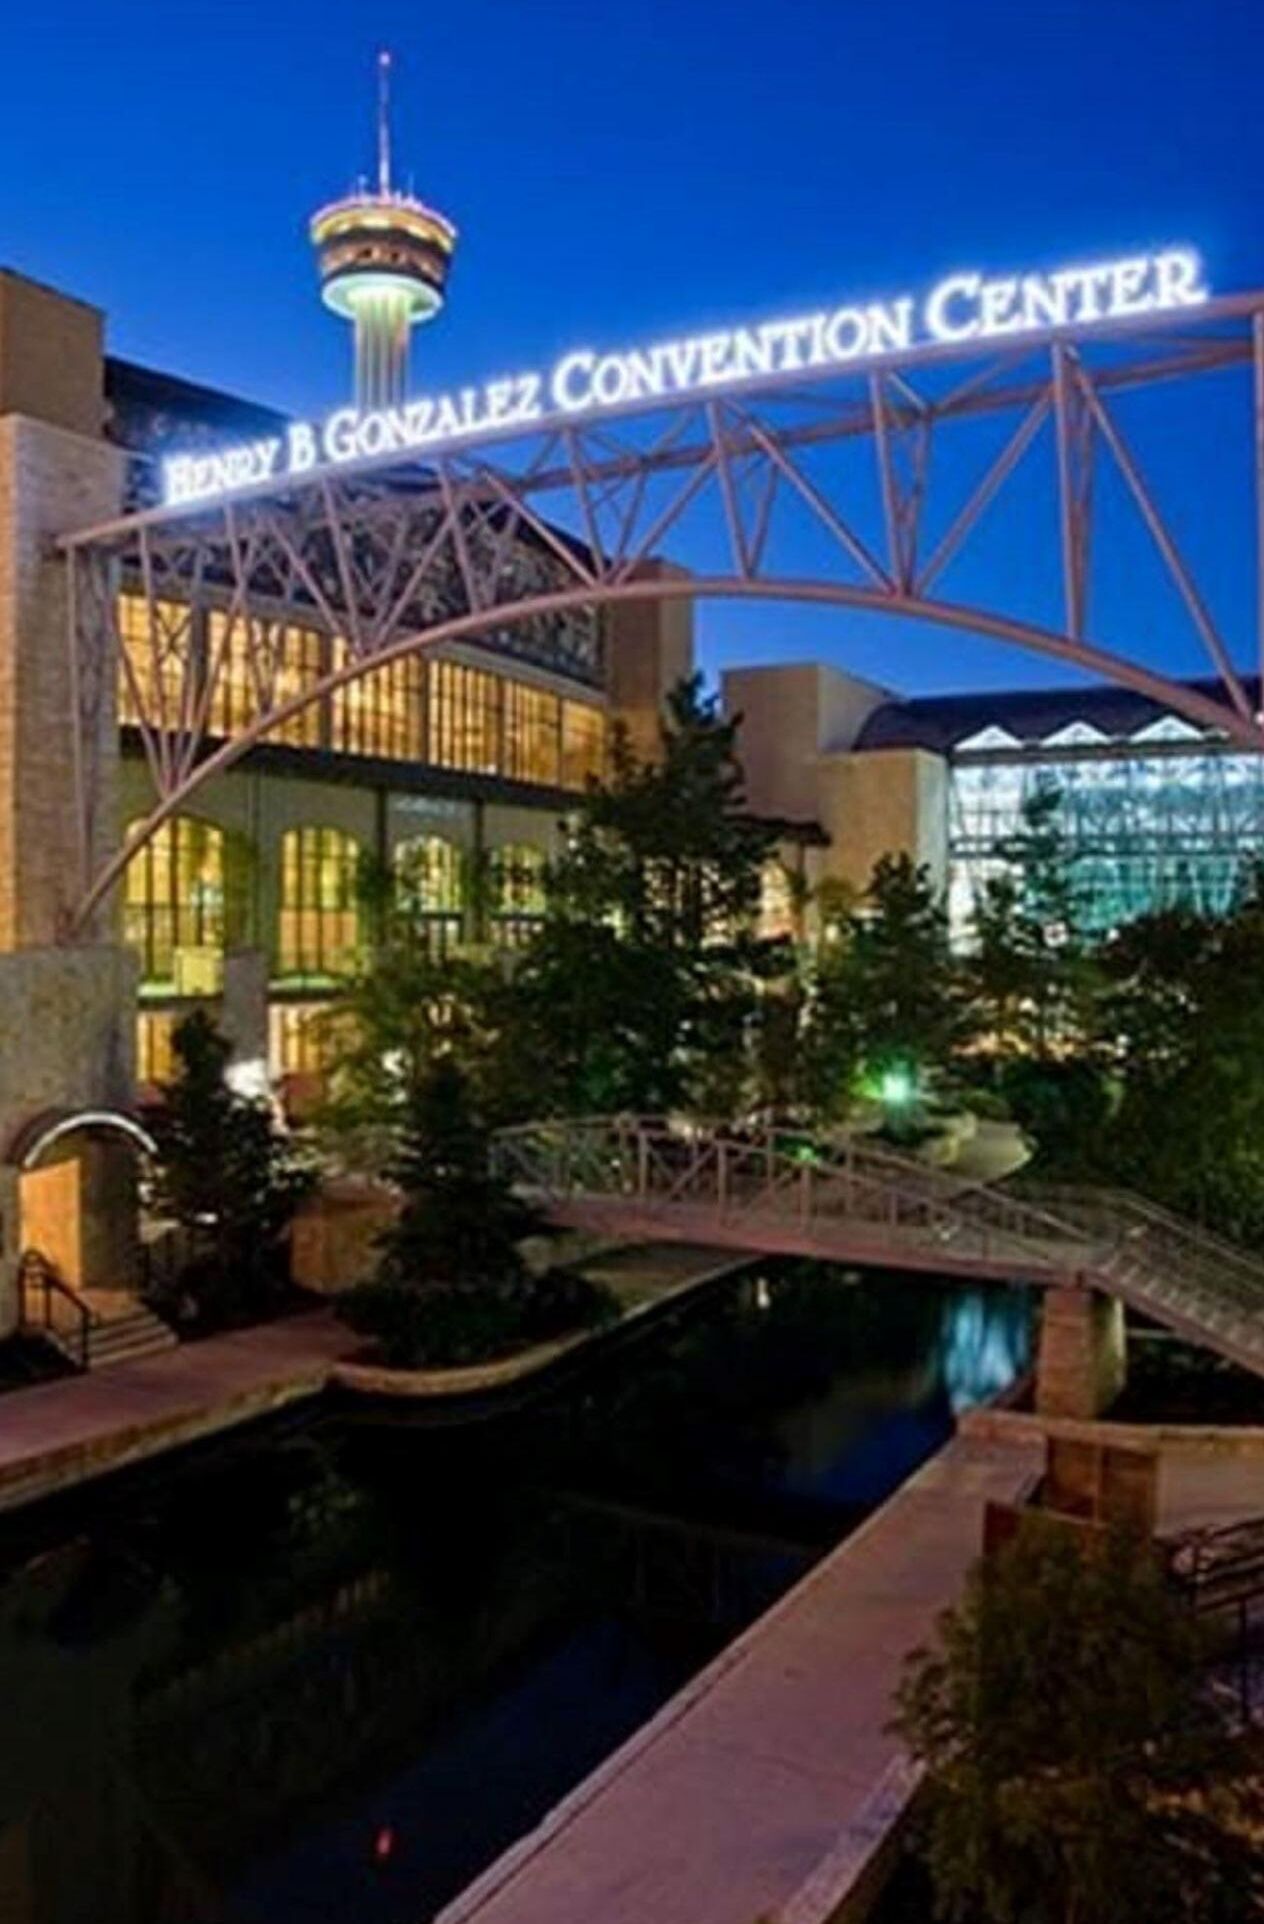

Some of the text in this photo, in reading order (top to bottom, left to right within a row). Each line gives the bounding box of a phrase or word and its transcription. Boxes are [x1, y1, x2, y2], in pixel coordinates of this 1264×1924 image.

[164, 250, 1207, 504] HENRY B GONZALEZ CONVENTION CENTER
